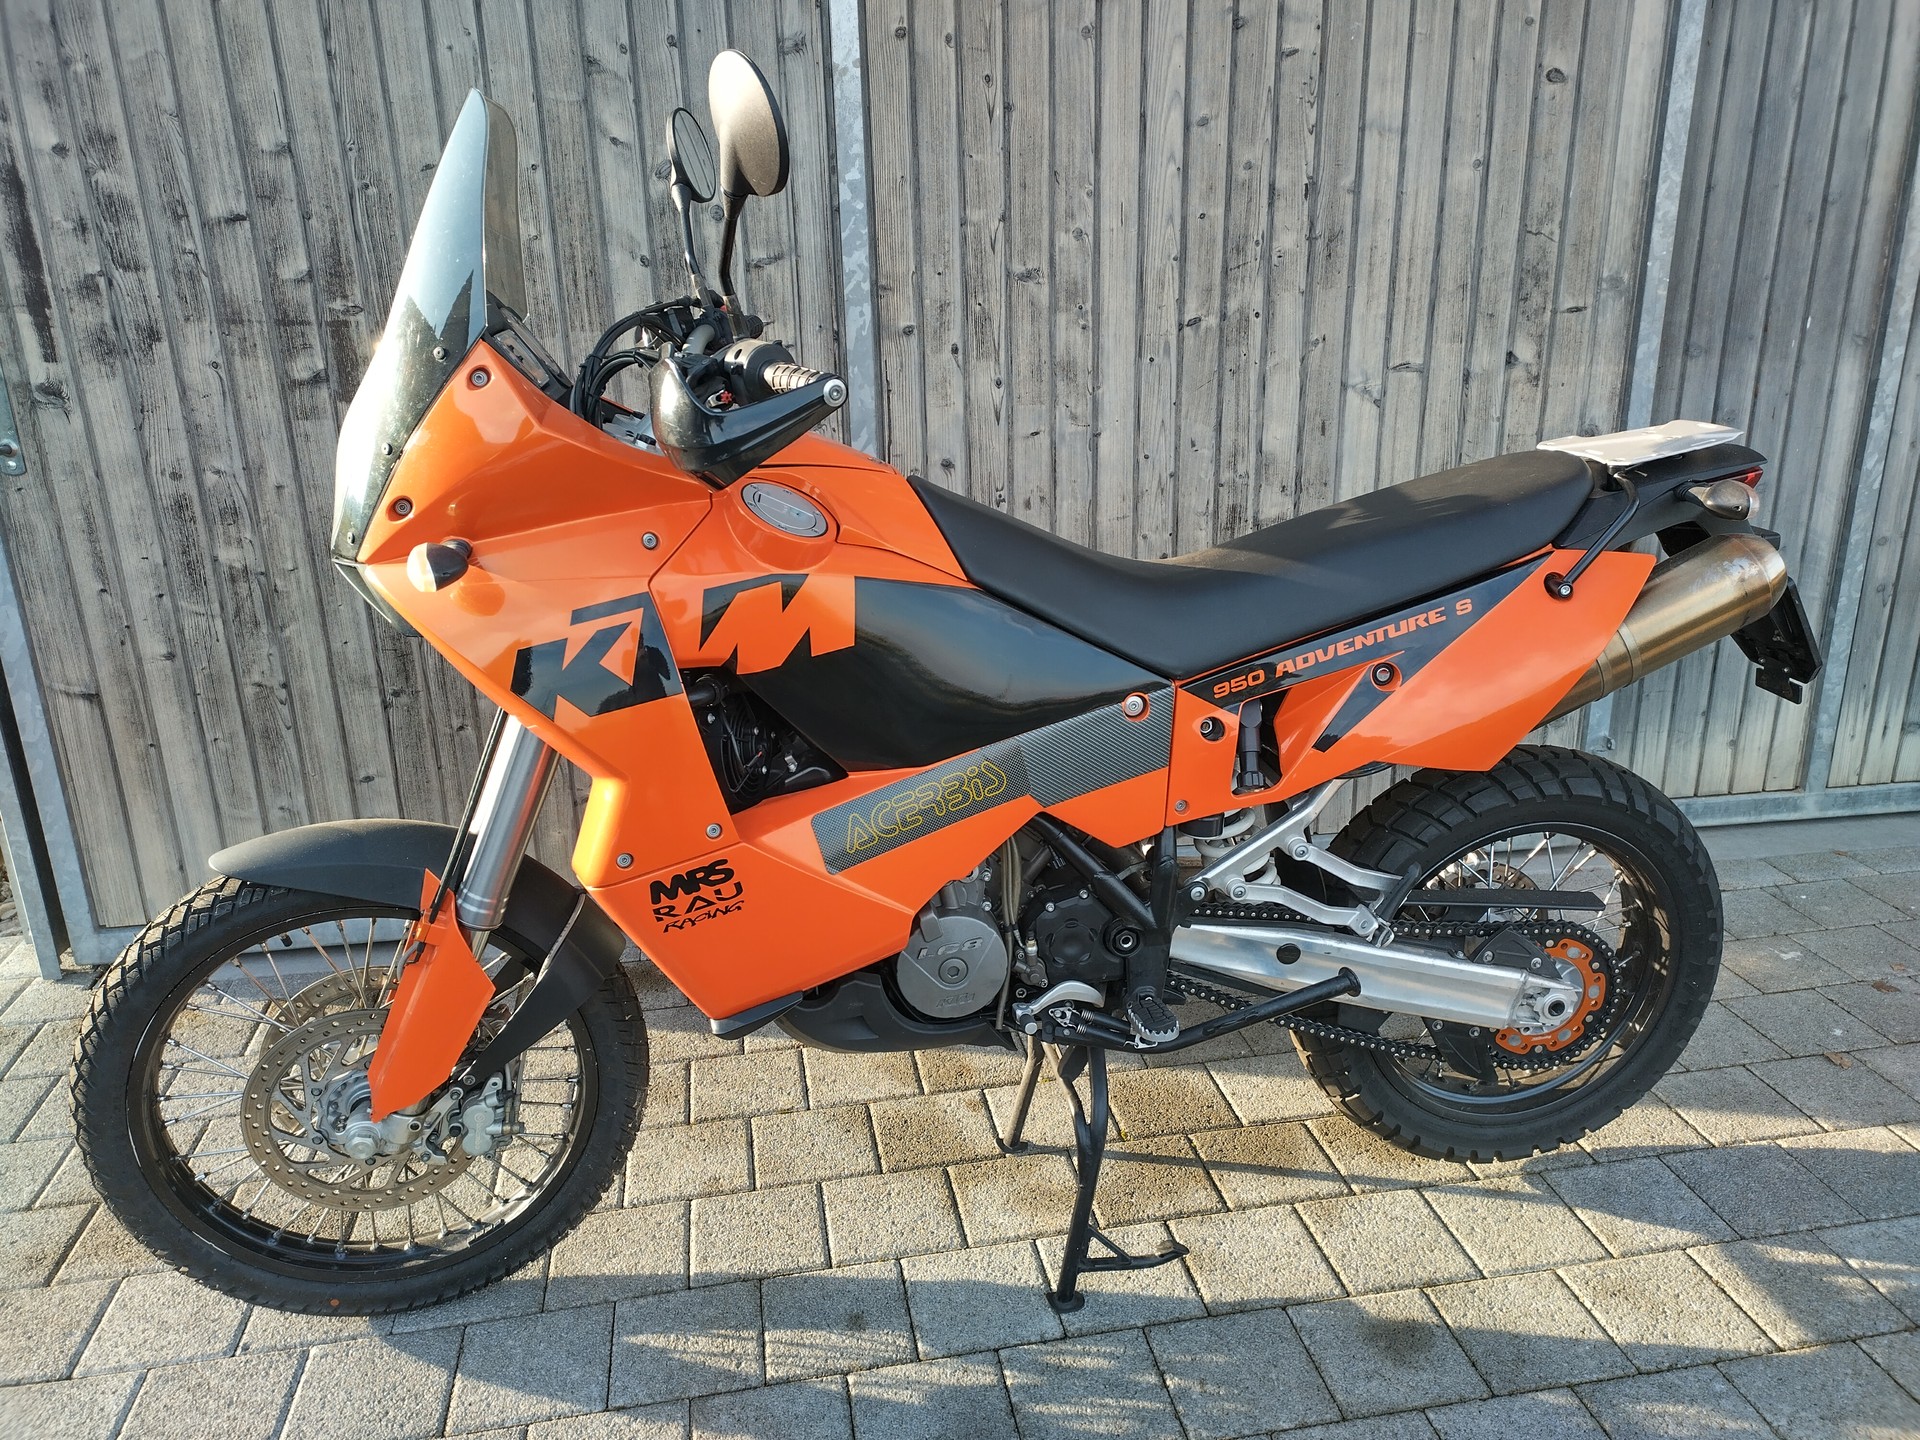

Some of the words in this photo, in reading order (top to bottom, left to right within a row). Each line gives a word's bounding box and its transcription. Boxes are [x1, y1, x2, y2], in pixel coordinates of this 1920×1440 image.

[510, 574, 856, 722] KTM
[1213, 669, 1265, 699] 950
[1275, 607, 1447, 677] ADVENTURE
[1455, 599, 1473, 616] S
[652, 881, 744, 922] RAU
[663, 900, 744, 933] RACING
[917, 937, 983, 960] LC8
